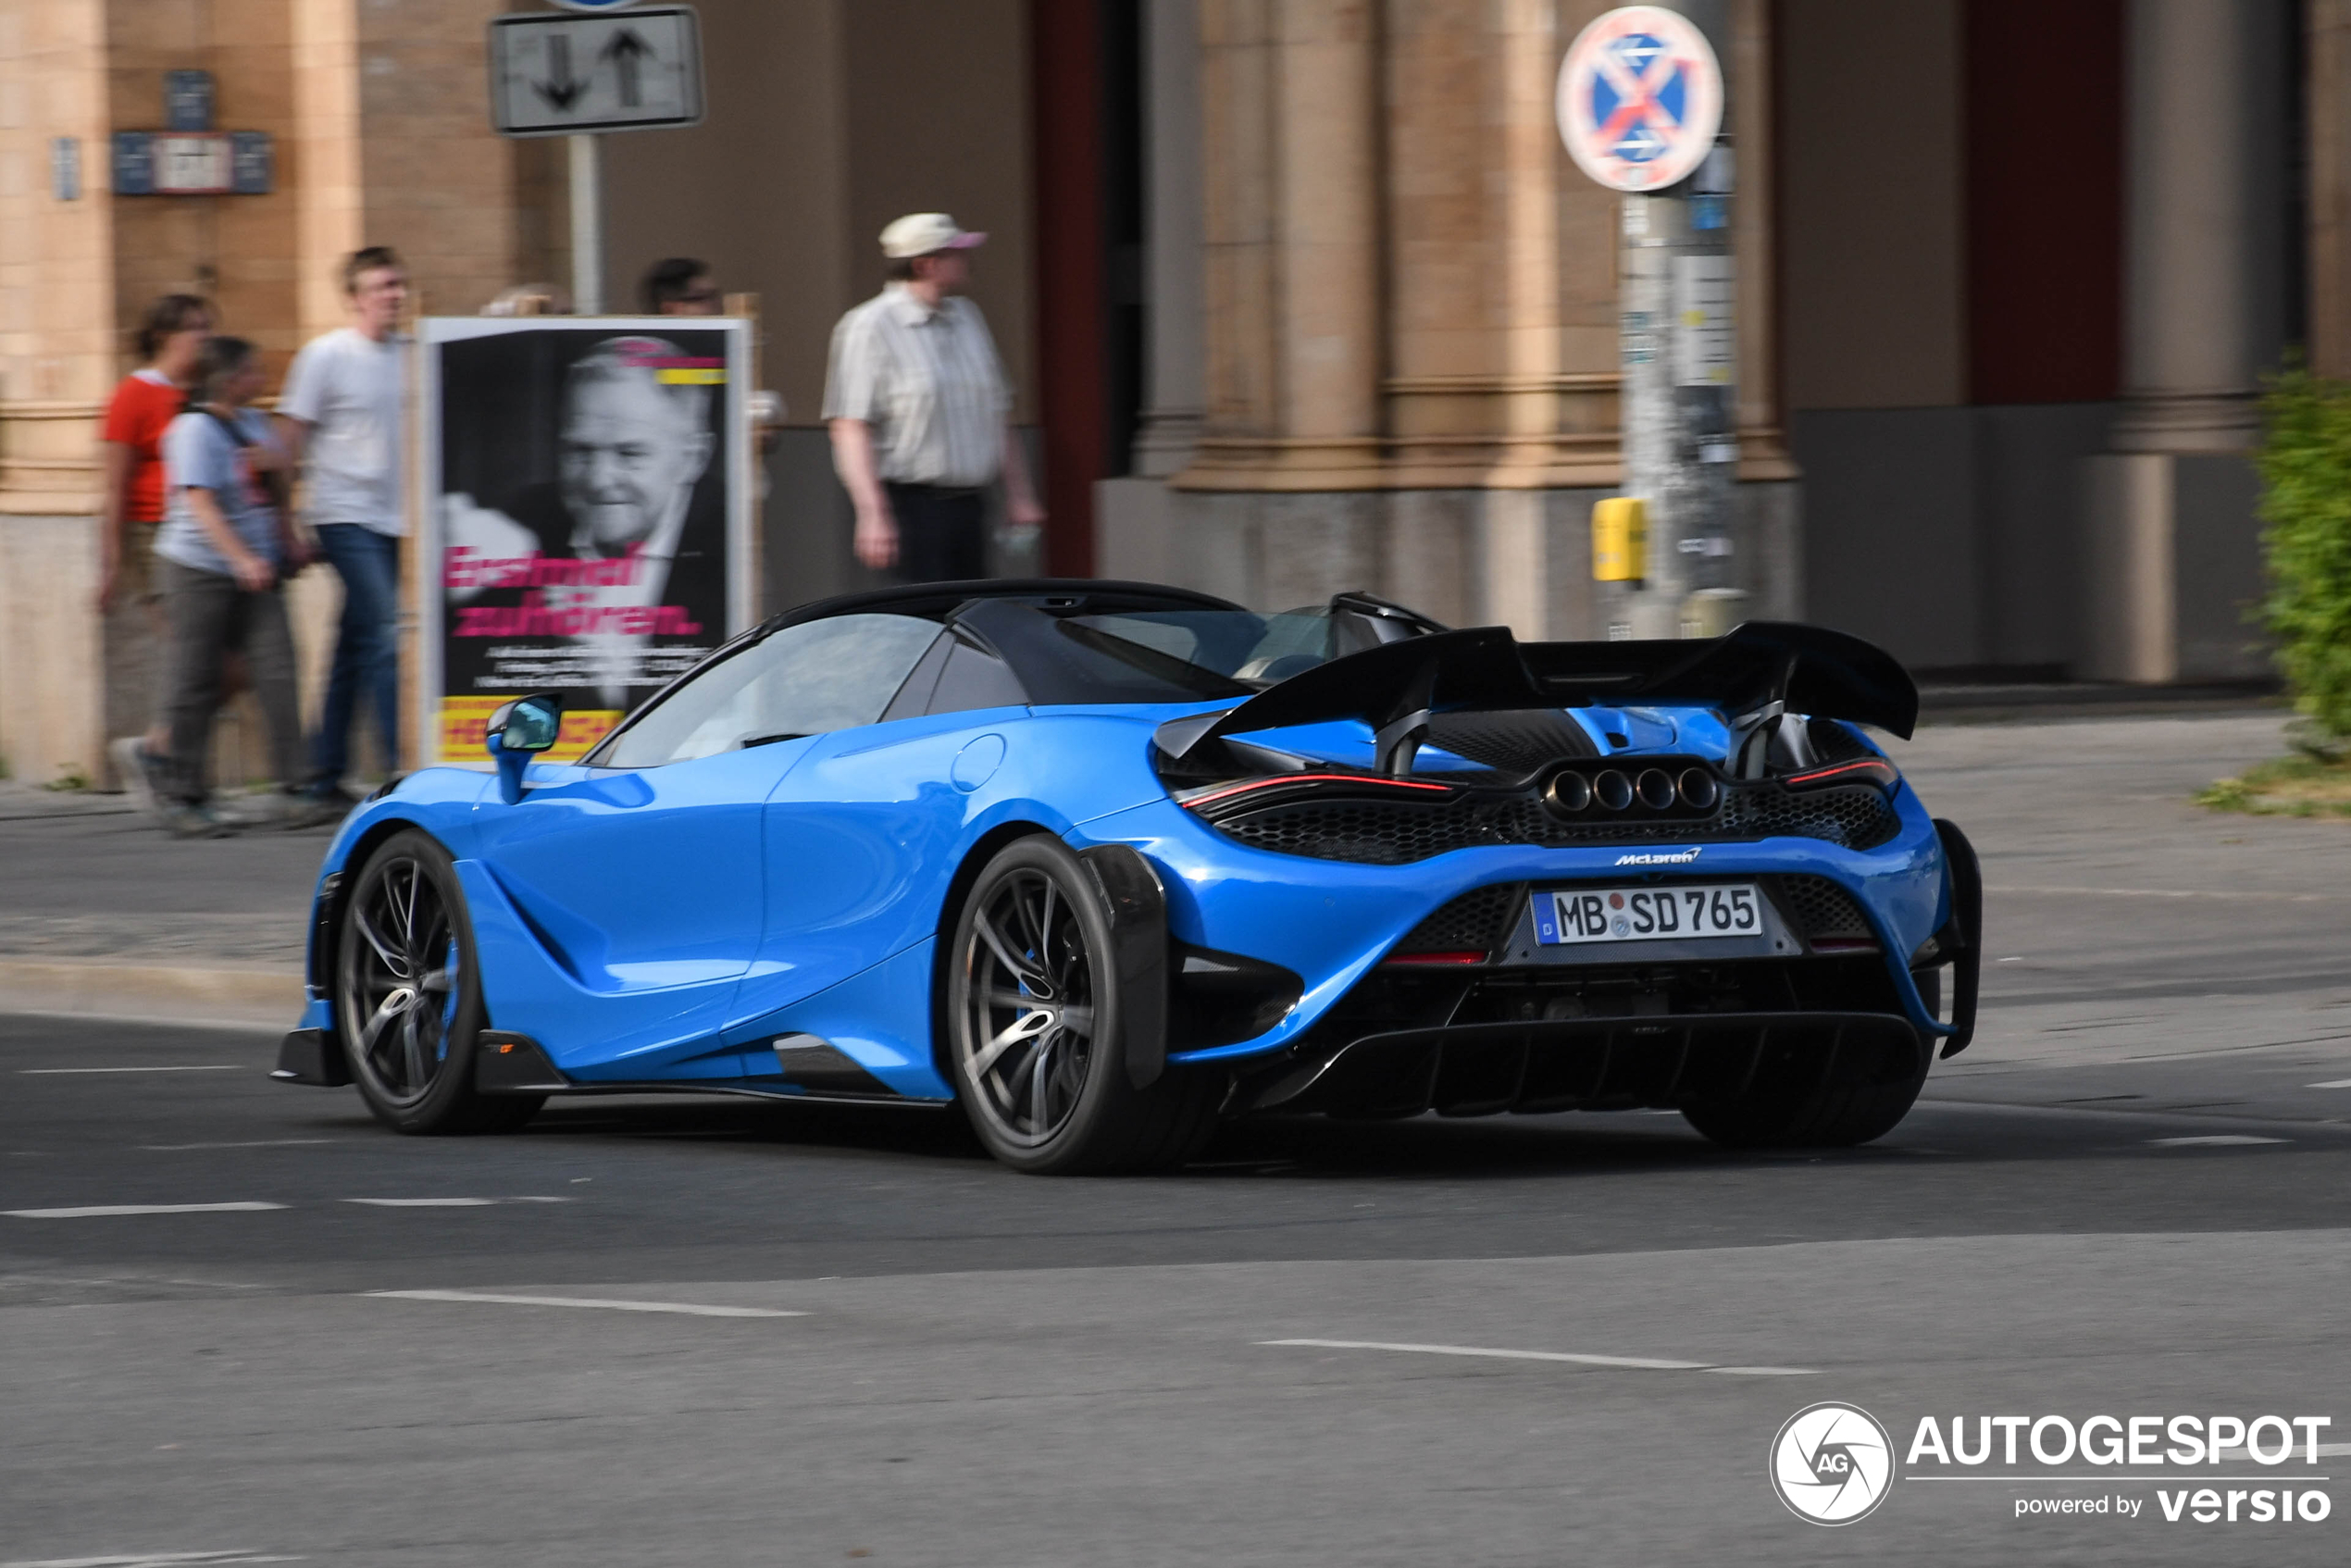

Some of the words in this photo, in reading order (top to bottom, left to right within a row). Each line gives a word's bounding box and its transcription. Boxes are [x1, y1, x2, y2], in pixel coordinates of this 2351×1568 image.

[1614, 852, 1695, 866] McLaren
[1556, 895, 1608, 938] MB
[1630, 892, 1679, 933] SD
[1685, 890, 1755, 931] 765
